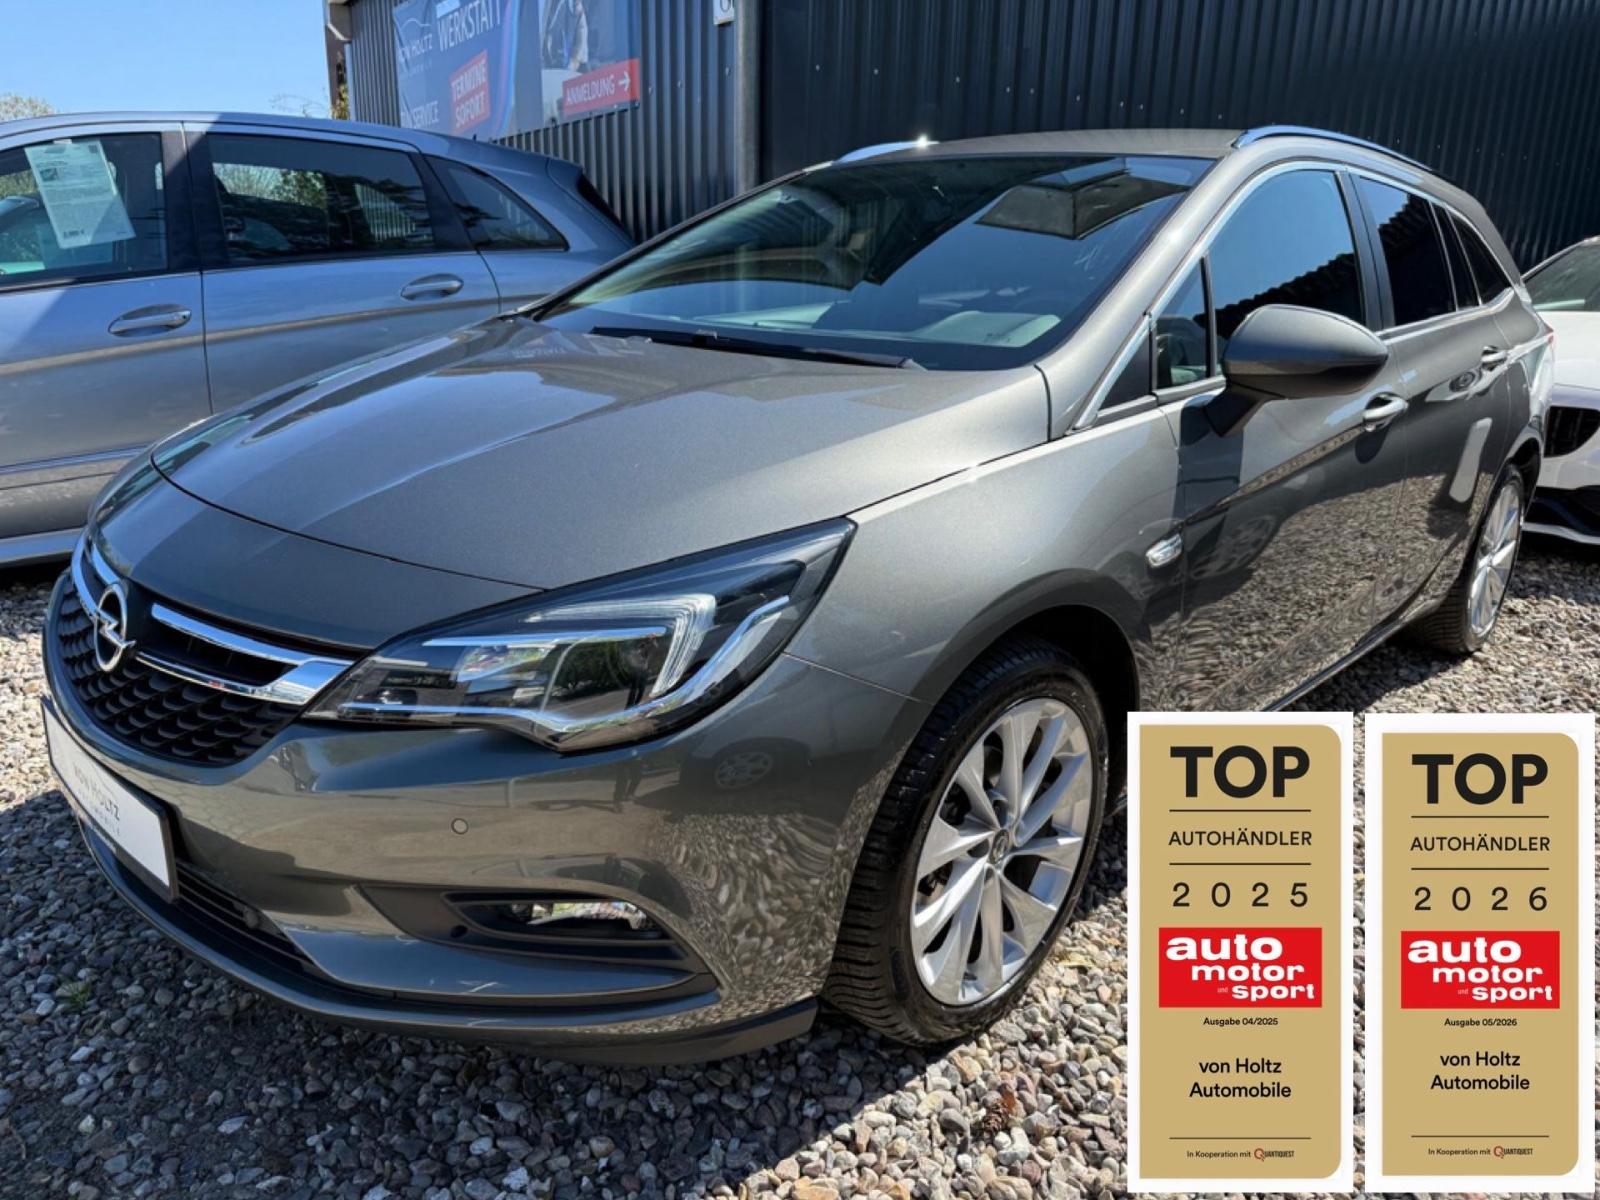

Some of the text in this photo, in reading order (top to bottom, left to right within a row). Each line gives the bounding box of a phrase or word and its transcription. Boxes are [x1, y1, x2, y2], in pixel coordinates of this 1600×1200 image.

[438, 0, 500, 52] WERKSTATT
[451, 58, 486, 103] TERMINE
[567, 74, 615, 105] ANMELDUNG
[456, 91, 485, 129] SOFORT
